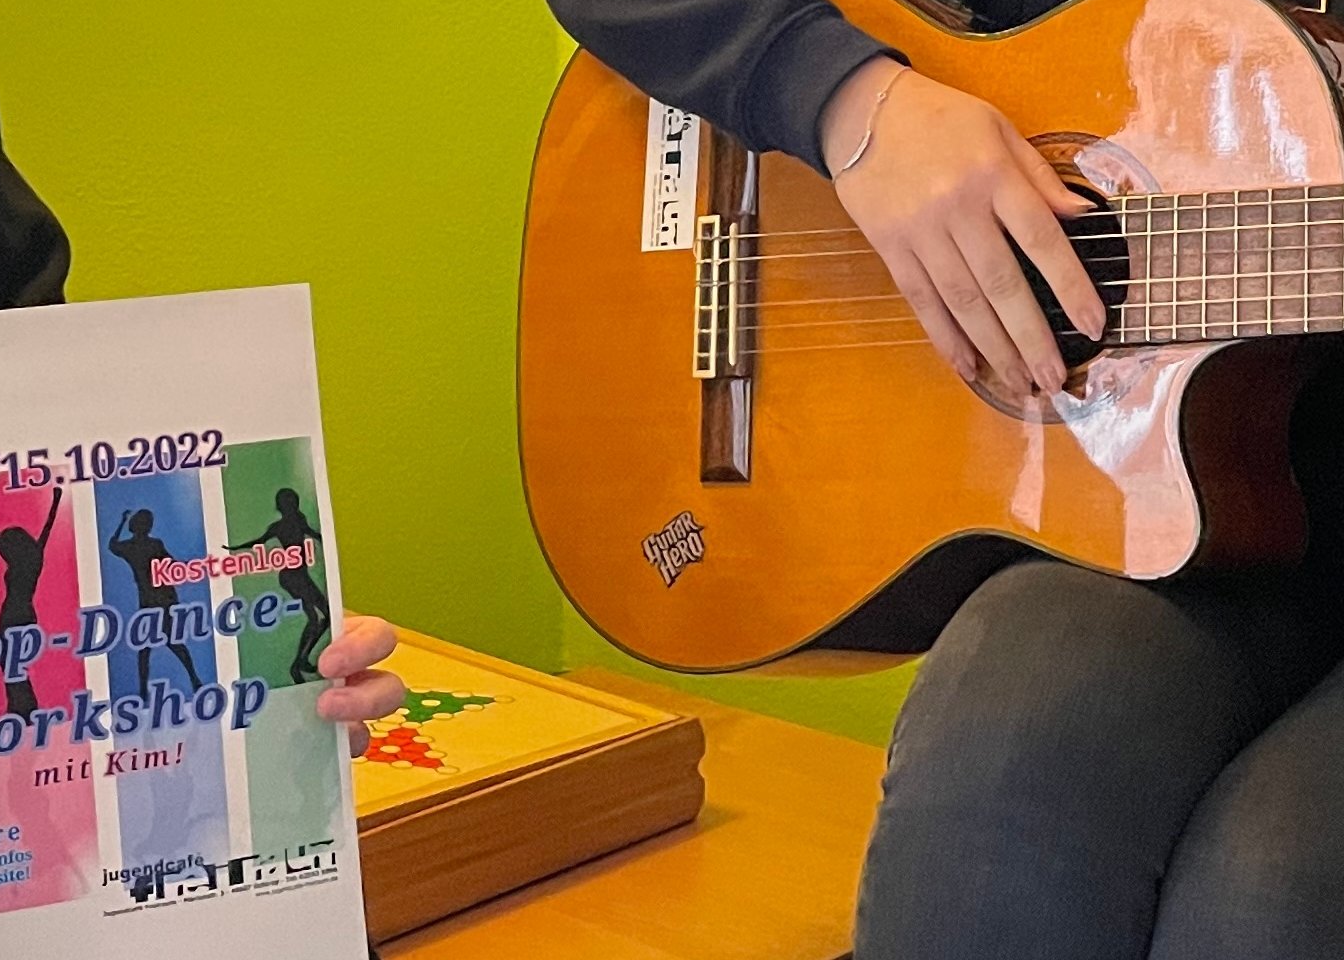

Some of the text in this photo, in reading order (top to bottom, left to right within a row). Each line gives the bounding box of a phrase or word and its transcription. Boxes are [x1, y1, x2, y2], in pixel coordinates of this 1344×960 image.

[151, 540, 315, 587] Kostenlos!
[33, 742, 185, 788] mit Kim!
[102, 852, 205, 887] jugendcafé
